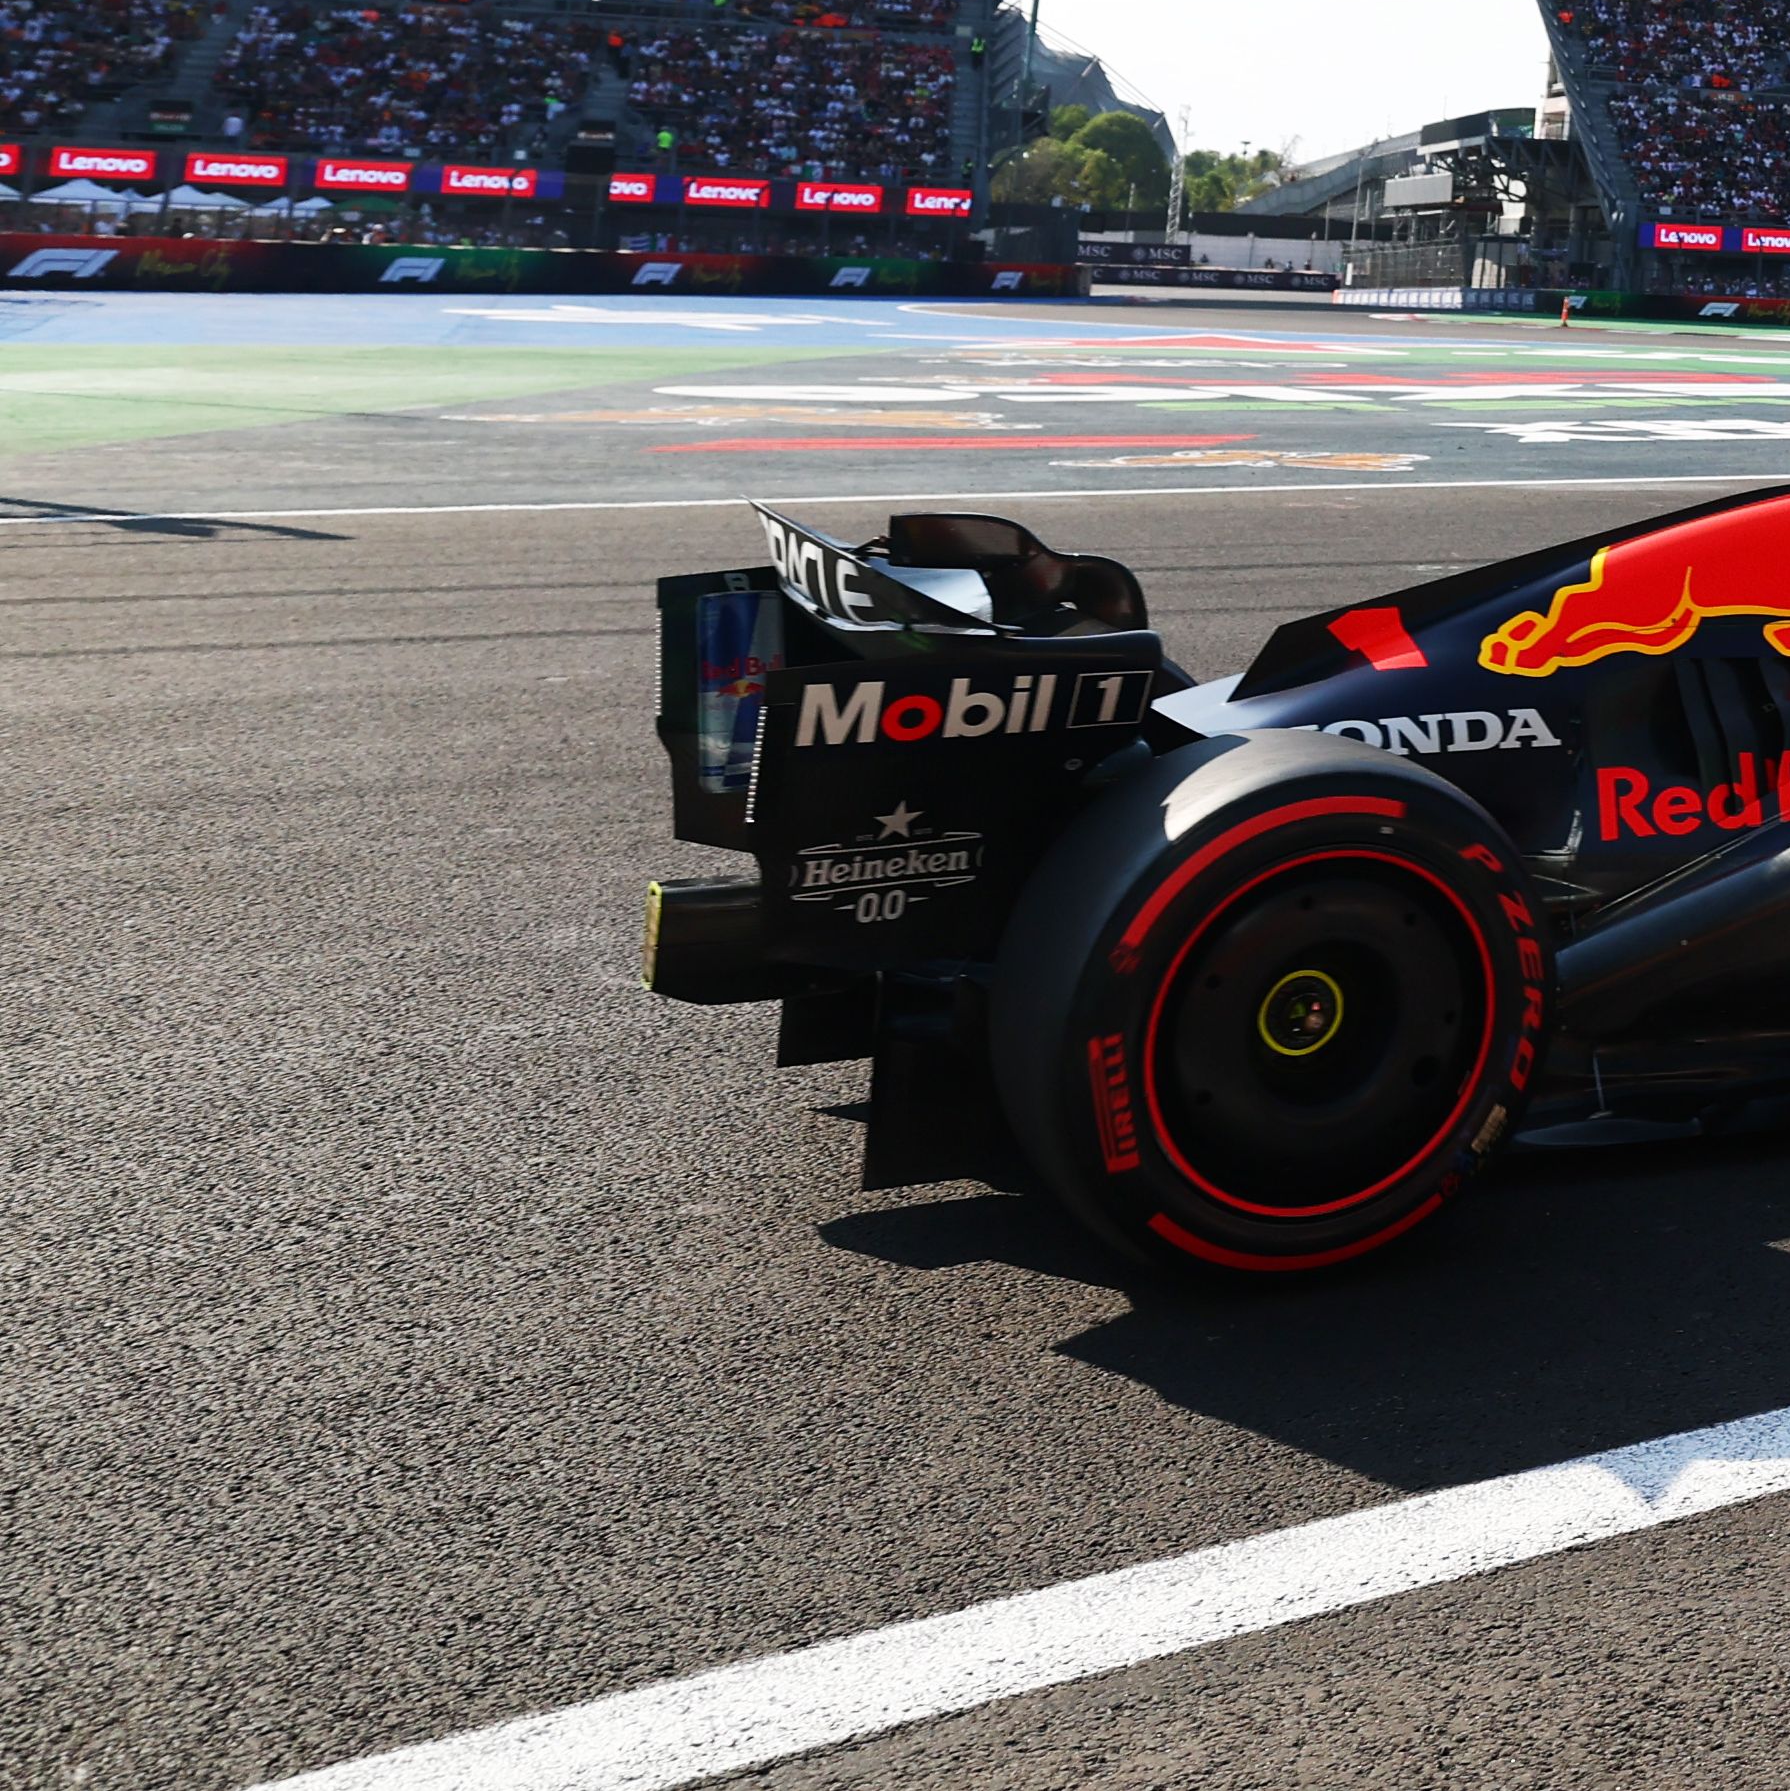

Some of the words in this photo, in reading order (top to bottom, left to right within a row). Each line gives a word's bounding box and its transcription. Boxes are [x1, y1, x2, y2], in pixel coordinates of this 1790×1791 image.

[59, 152, 148, 173] Lenovo
[193, 159, 279, 179] Lenovo
[323, 164, 406, 185] Lenovo
[1149, 248, 1183, 260] MSC
[1698, 302, 1740, 317] F1
[795, 674, 1057, 748] Mobil
[1097, 677, 1126, 723] 1
[1298, 708, 1562, 756] ONDA
[1597, 751, 1763, 842] Red
[802, 849, 971, 888] Heineken
[855, 889, 907, 924] 0.0
[1458, 842, 1504, 873] P
[1498, 889, 1544, 1092] ZERO
[1088, 1032, 1141, 1174] PIRELLI
